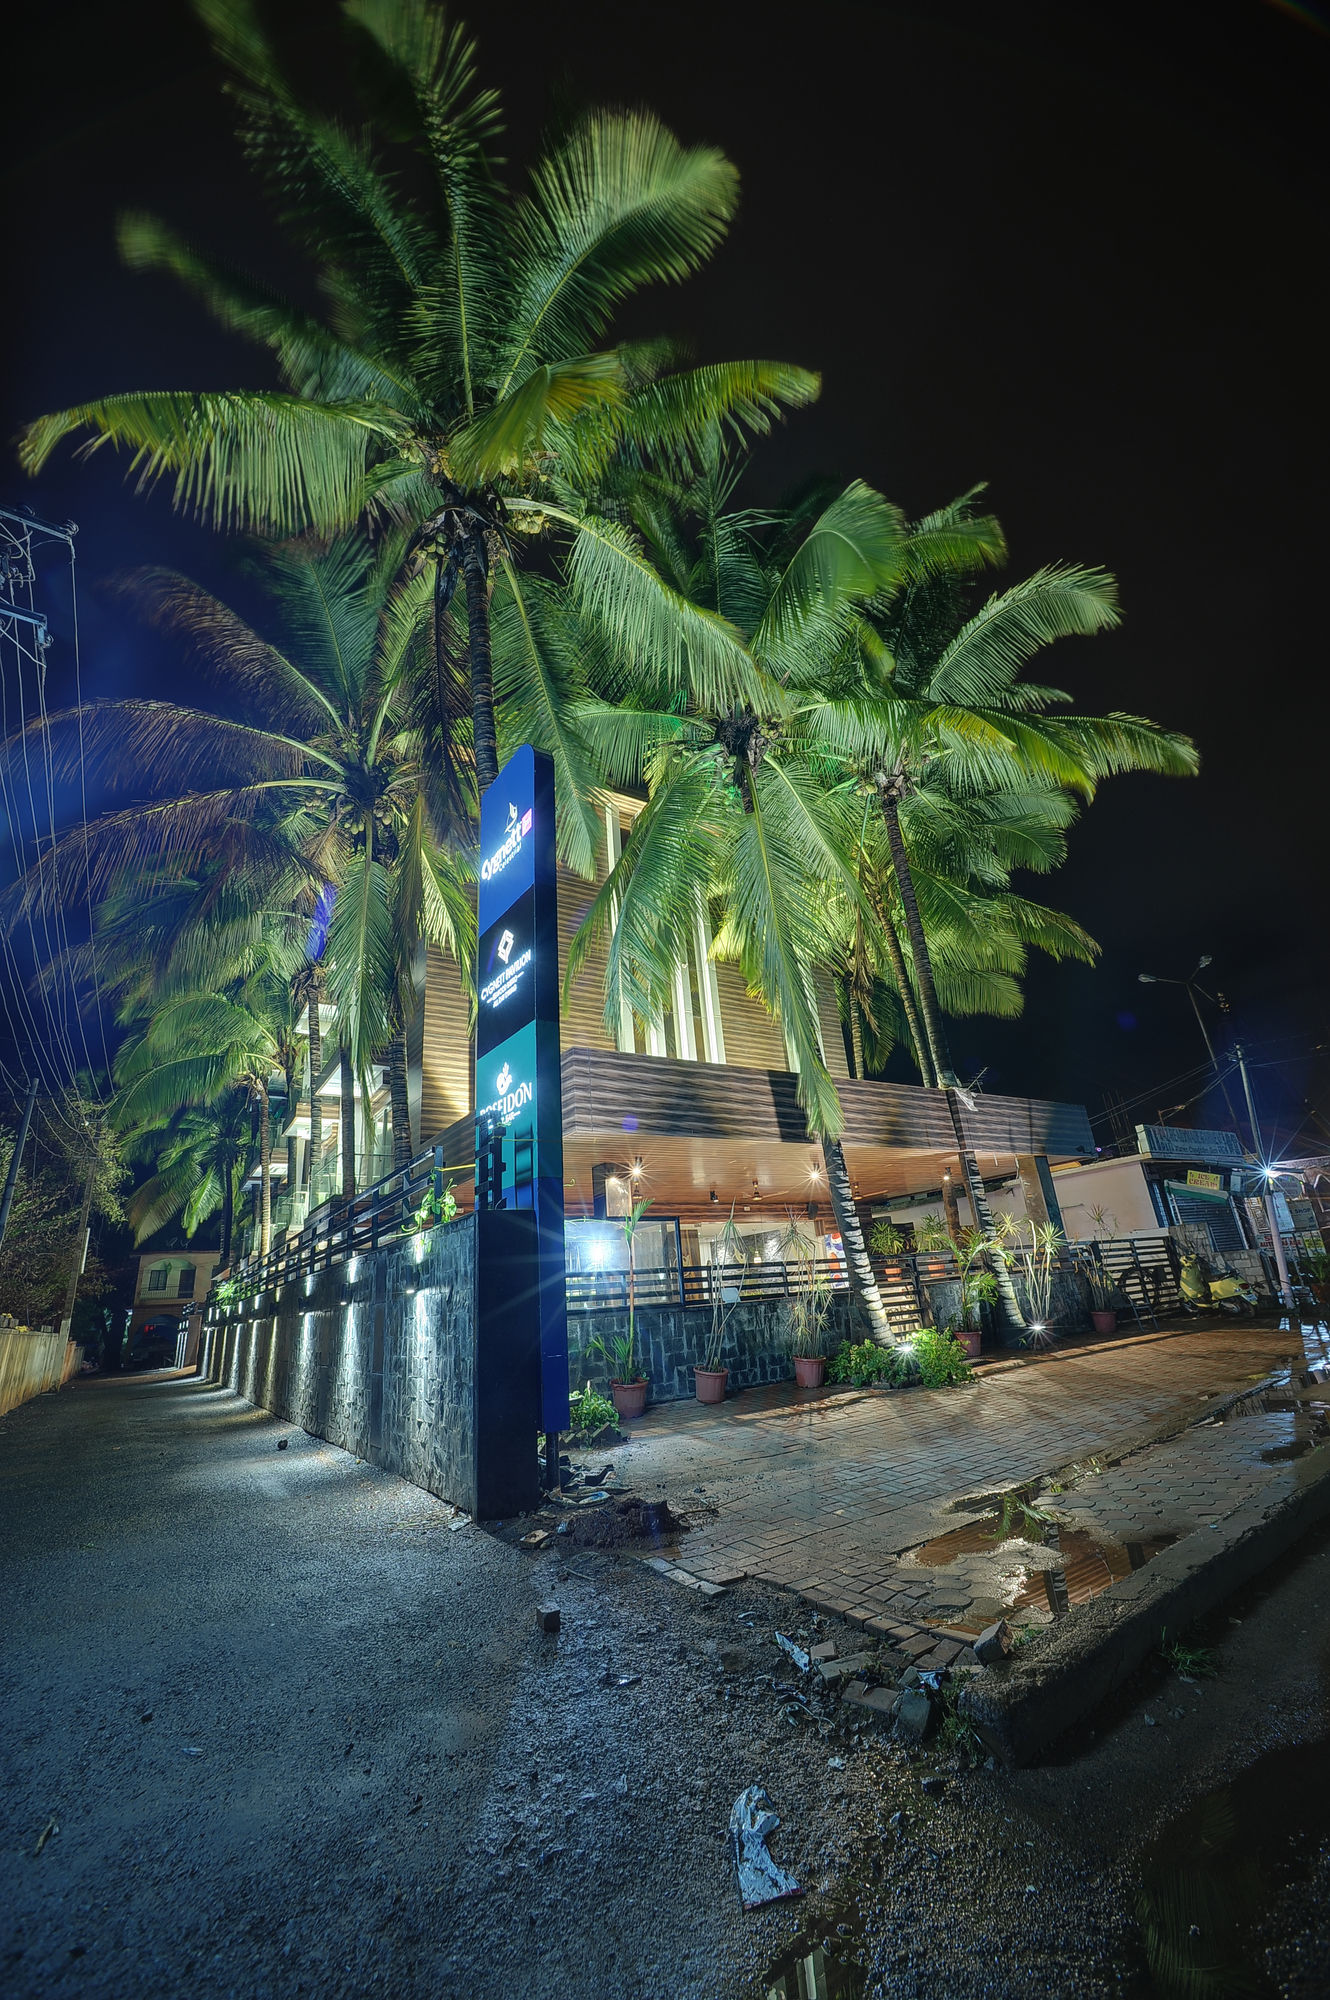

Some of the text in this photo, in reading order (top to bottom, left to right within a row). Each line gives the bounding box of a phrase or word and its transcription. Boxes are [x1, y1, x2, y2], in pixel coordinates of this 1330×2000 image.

[481, 822, 521, 880] Cygnett
[481, 972, 506, 1000] CYGNETT
[506, 949, 531, 980] PAVILION
[1188, 1179, 1218, 1189] CREAM
